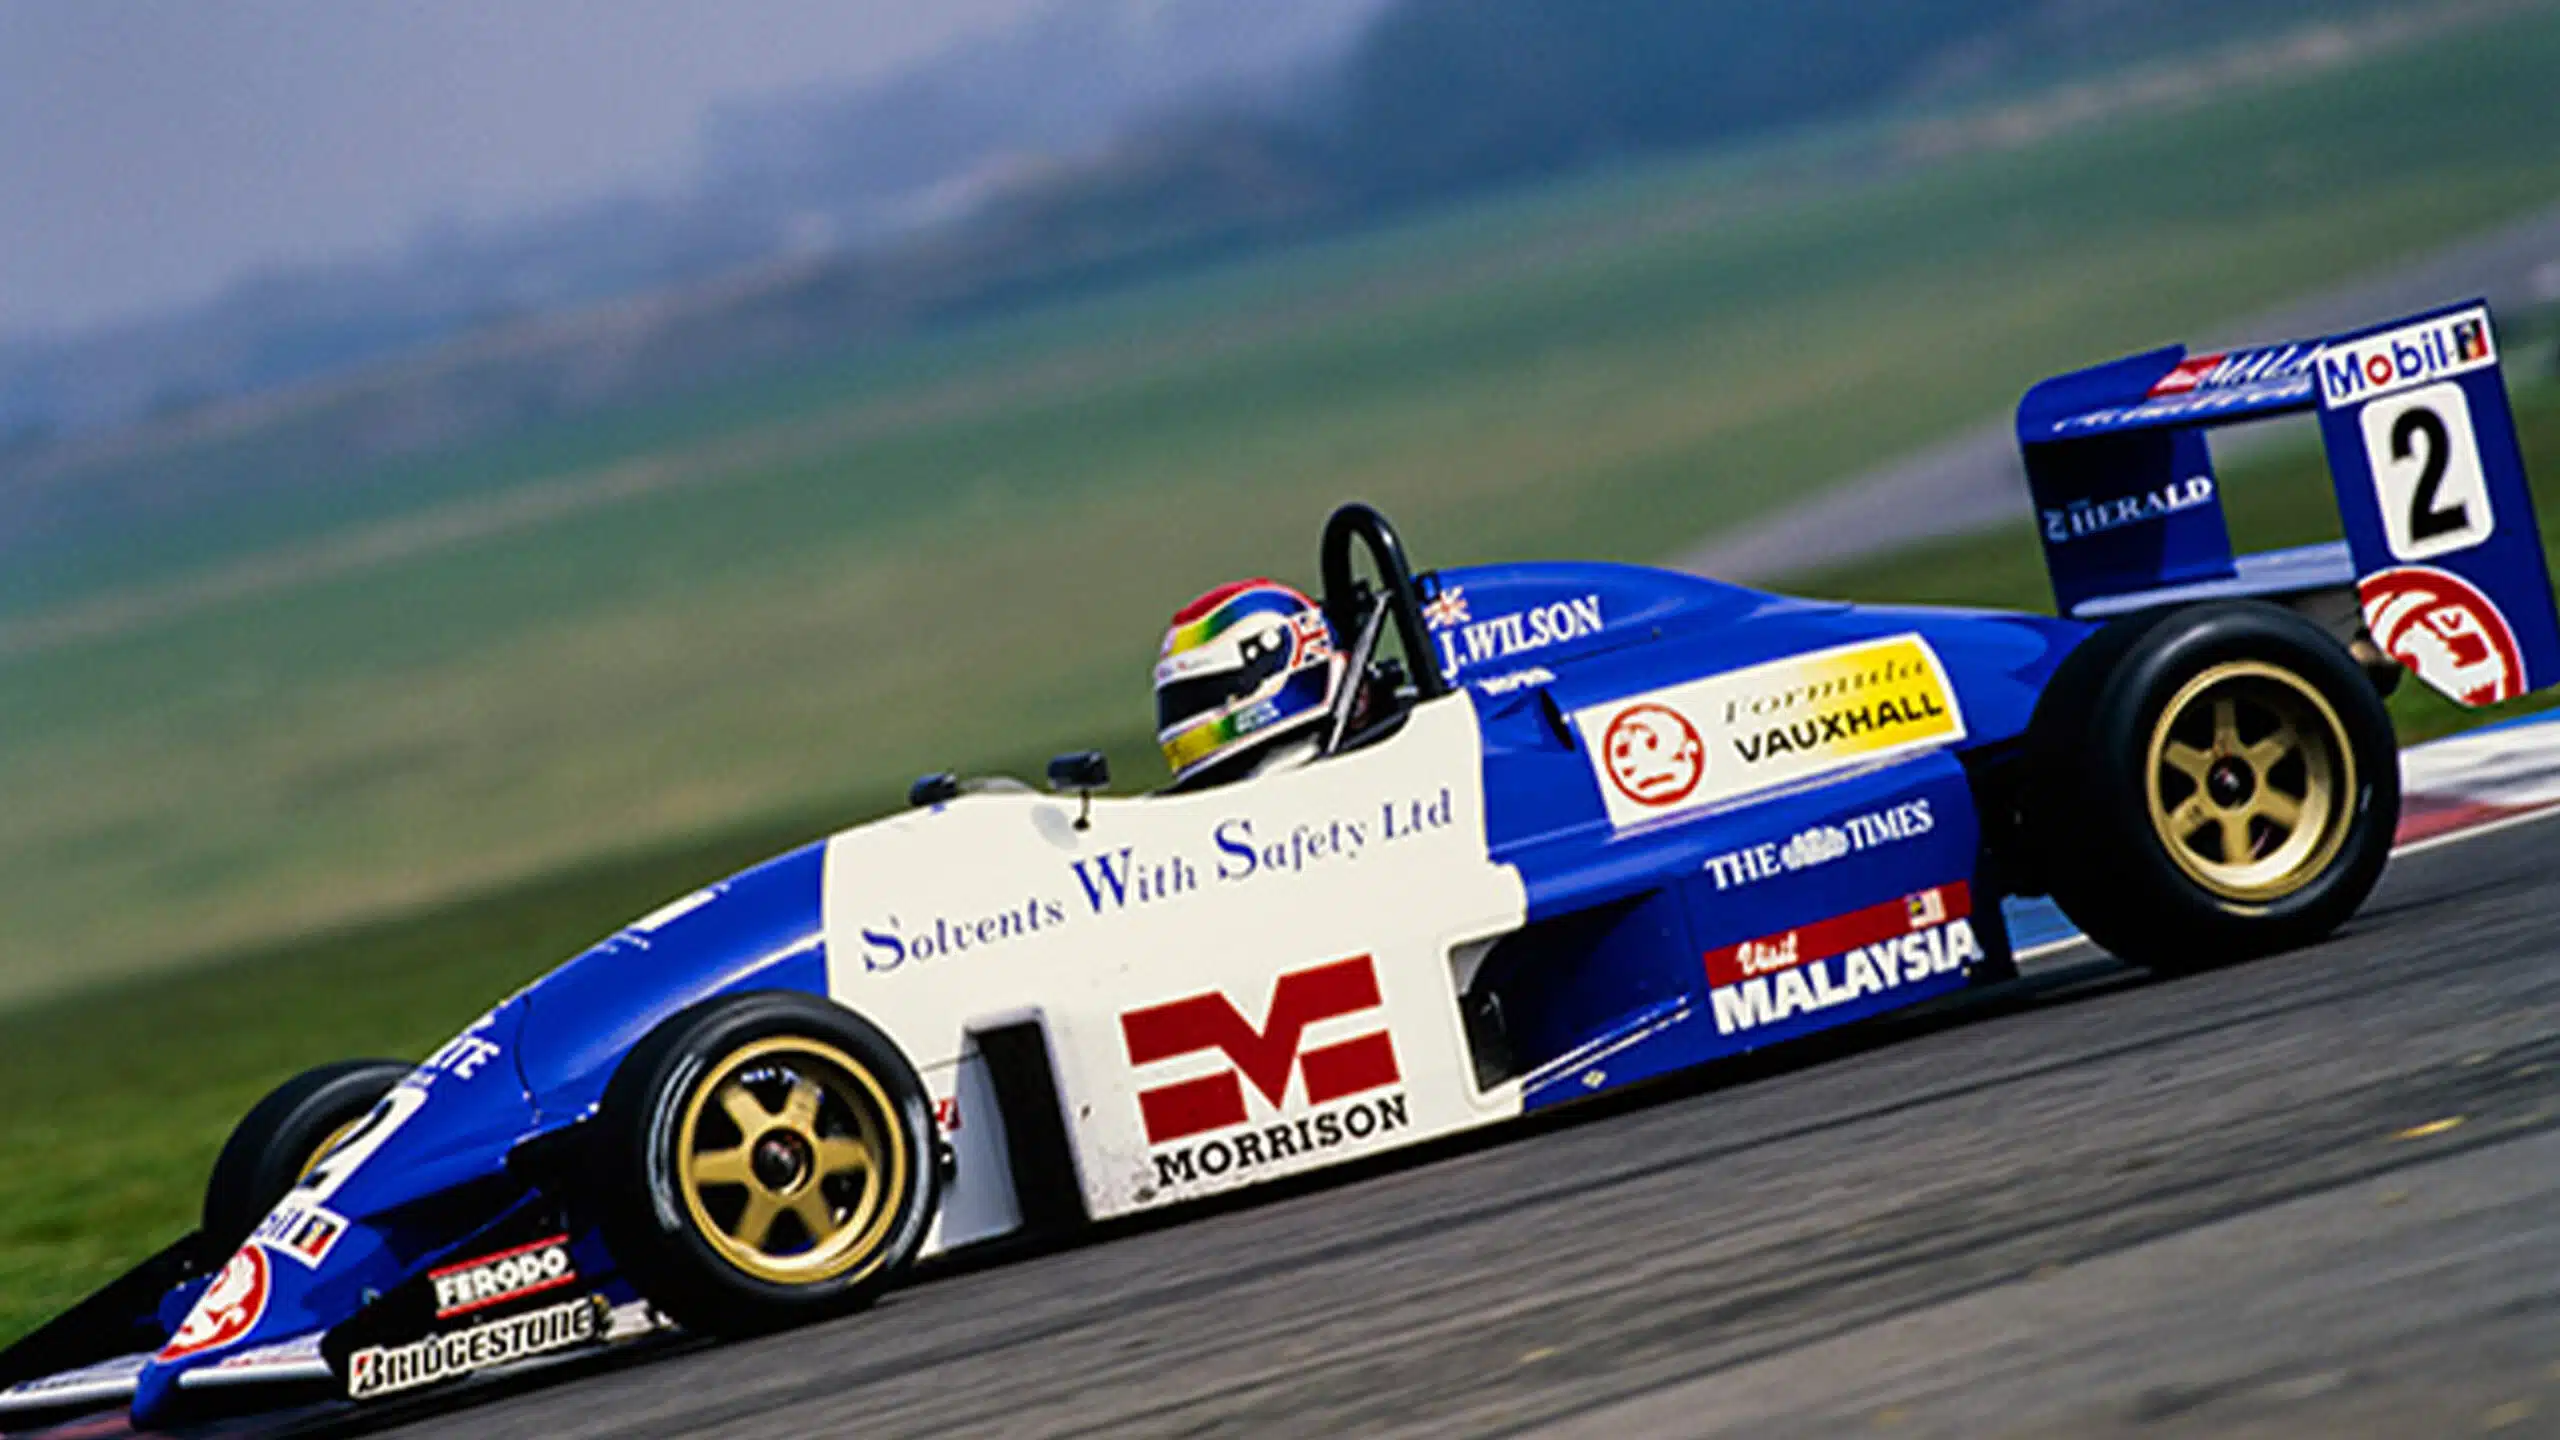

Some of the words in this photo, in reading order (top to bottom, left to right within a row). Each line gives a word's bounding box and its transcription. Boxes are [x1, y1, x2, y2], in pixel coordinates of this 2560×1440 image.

[2324, 328, 2449, 398] Mobil
[2071, 475, 2213, 536] HERALD
[2390, 406, 2468, 544] 2
[1733, 692, 1944, 763] VAUXHALL
[861, 897, 1065, 973] Solvents
[1070, 846, 1197, 914] With
[1213, 817, 1367, 880] Safety
[1382, 787, 1453, 840] Ltd
[1703, 842, 1782, 891] THE
[1844, 797, 1934, 851] TIMES
[1709, 917, 1985, 1036] MALAYSIA
[1736, 929, 1799, 976] Visit
[1153, 1092, 1409, 1188] MORRISON
[435, 1247, 568, 1310] FERODO
[353, 1300, 595, 1396] BRIDGESTONE
